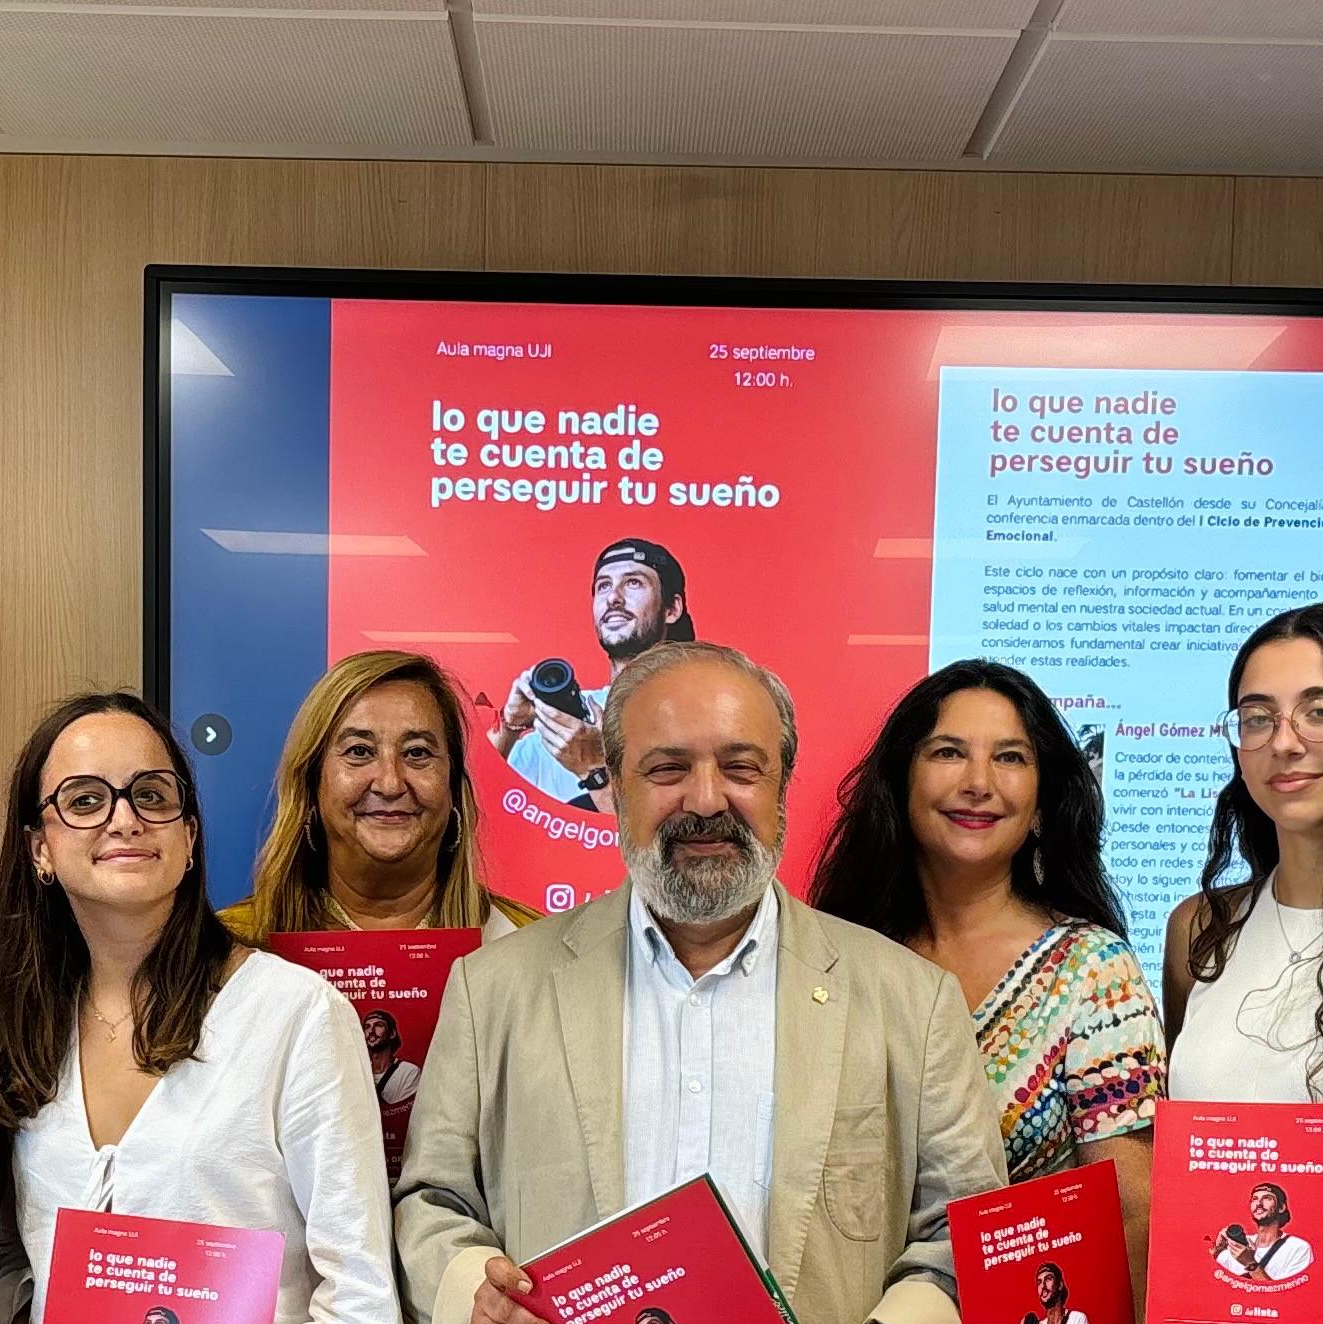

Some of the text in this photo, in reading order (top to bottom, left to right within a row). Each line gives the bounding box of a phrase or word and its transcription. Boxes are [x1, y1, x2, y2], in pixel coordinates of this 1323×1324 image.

[436, 341, 551, 360] Aula magna UJI
[710, 344, 815, 362] 25 septiembre
[735, 372, 792, 387] 12:00 h.
[993, 388, 1176, 419] lo que nadie
[433, 400, 659, 440] lo que nadie
[990, 420, 1179, 445] te cuenta de
[430, 437, 663, 471] te cuenta de
[990, 449, 1273, 479] perseguir tu sueño
[431, 473, 780, 511] perseguir tu sueño
[1007, 495, 1092, 509] Ayuntamiento
[1101, 496, 1118, 508] de
[1127, 496, 1184, 509] Castellón
[1193, 497, 1232, 509] desde
[1241, 500, 1256, 510] su
[986, 512, 1058, 525] conferencia
[1061, 514, 1130, 526] enmarcada
[1133, 514, 1174, 526] dentro
[1177, 515, 1195, 527] del
[1207, 515, 1240, 527] Ciclo
[1244, 516, 1260, 527] de
[986, 530, 1057, 541] Emocional.
[985, 565, 1010, 577] Este
[1015, 566, 1043, 578] ciclo
[1048, 568, 1078, 578] nace
[1083, 569, 1106, 579] con
[1111, 570, 1127, 579] un
[1132, 568, 1189, 582] propósito
[1293, 570, 1305, 582] el
[1115, 719, 1205, 740] Ángel Gómez
[502, 788, 620, 849] @angelgo
[1190, 1135, 1277, 1151] lo que nadie
[1190, 1148, 1279, 1161] te cuenta de
[1189, 1160, 1323, 1175] perseguir tu sueño
[89, 1249, 177, 1270] lo que nadie
[88, 1264, 177, 1283] te cuenta de
[86, 1277, 219, 1301] perseguir tu sueño
